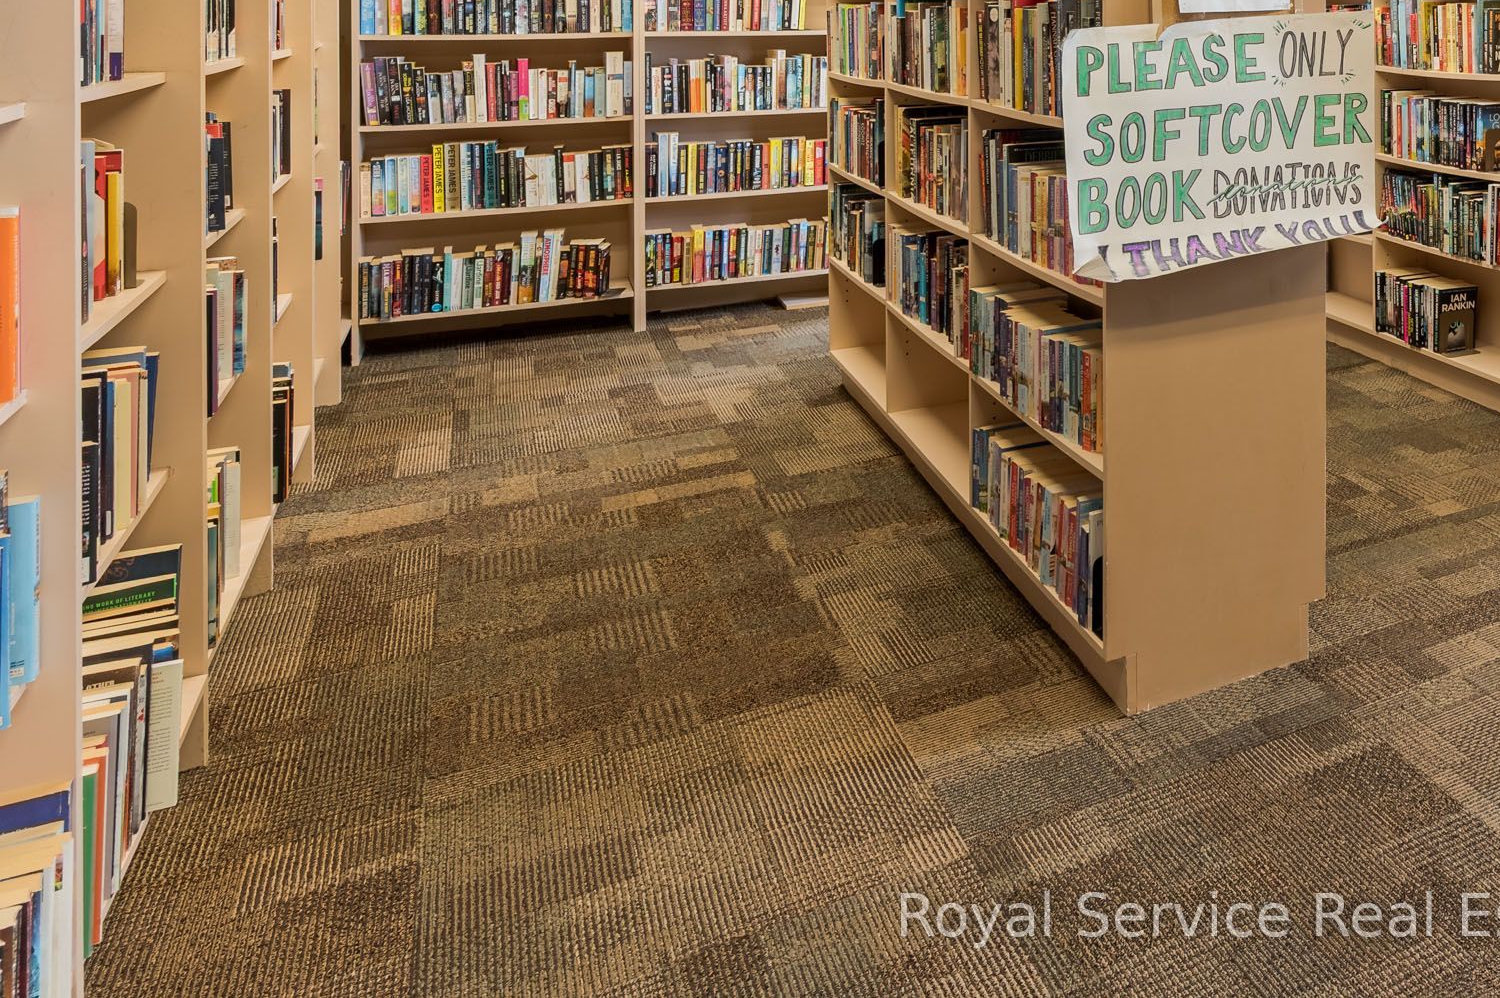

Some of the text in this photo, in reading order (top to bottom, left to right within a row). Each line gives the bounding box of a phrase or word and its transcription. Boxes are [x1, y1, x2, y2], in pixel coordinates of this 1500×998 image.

[1076, 29, 1353, 97] PLEASE ONLY
[1083, 93, 1372, 166] SOFTCOVER
[434, 147, 442, 169] PETER
[448, 144, 456, 193] PETER JAMES
[486, 145, 494, 191] PETER JAMES
[1077, 162, 1362, 235] BOOK DONATIONS
[542, 237, 552, 276] ATMOSPHERE
[1442, 301, 1475, 312] RANKIN
[1451, 293, 1467, 302] IAN
[96, 600, 114, 608] WORK
[124, 591, 156, 602] LITERARY
